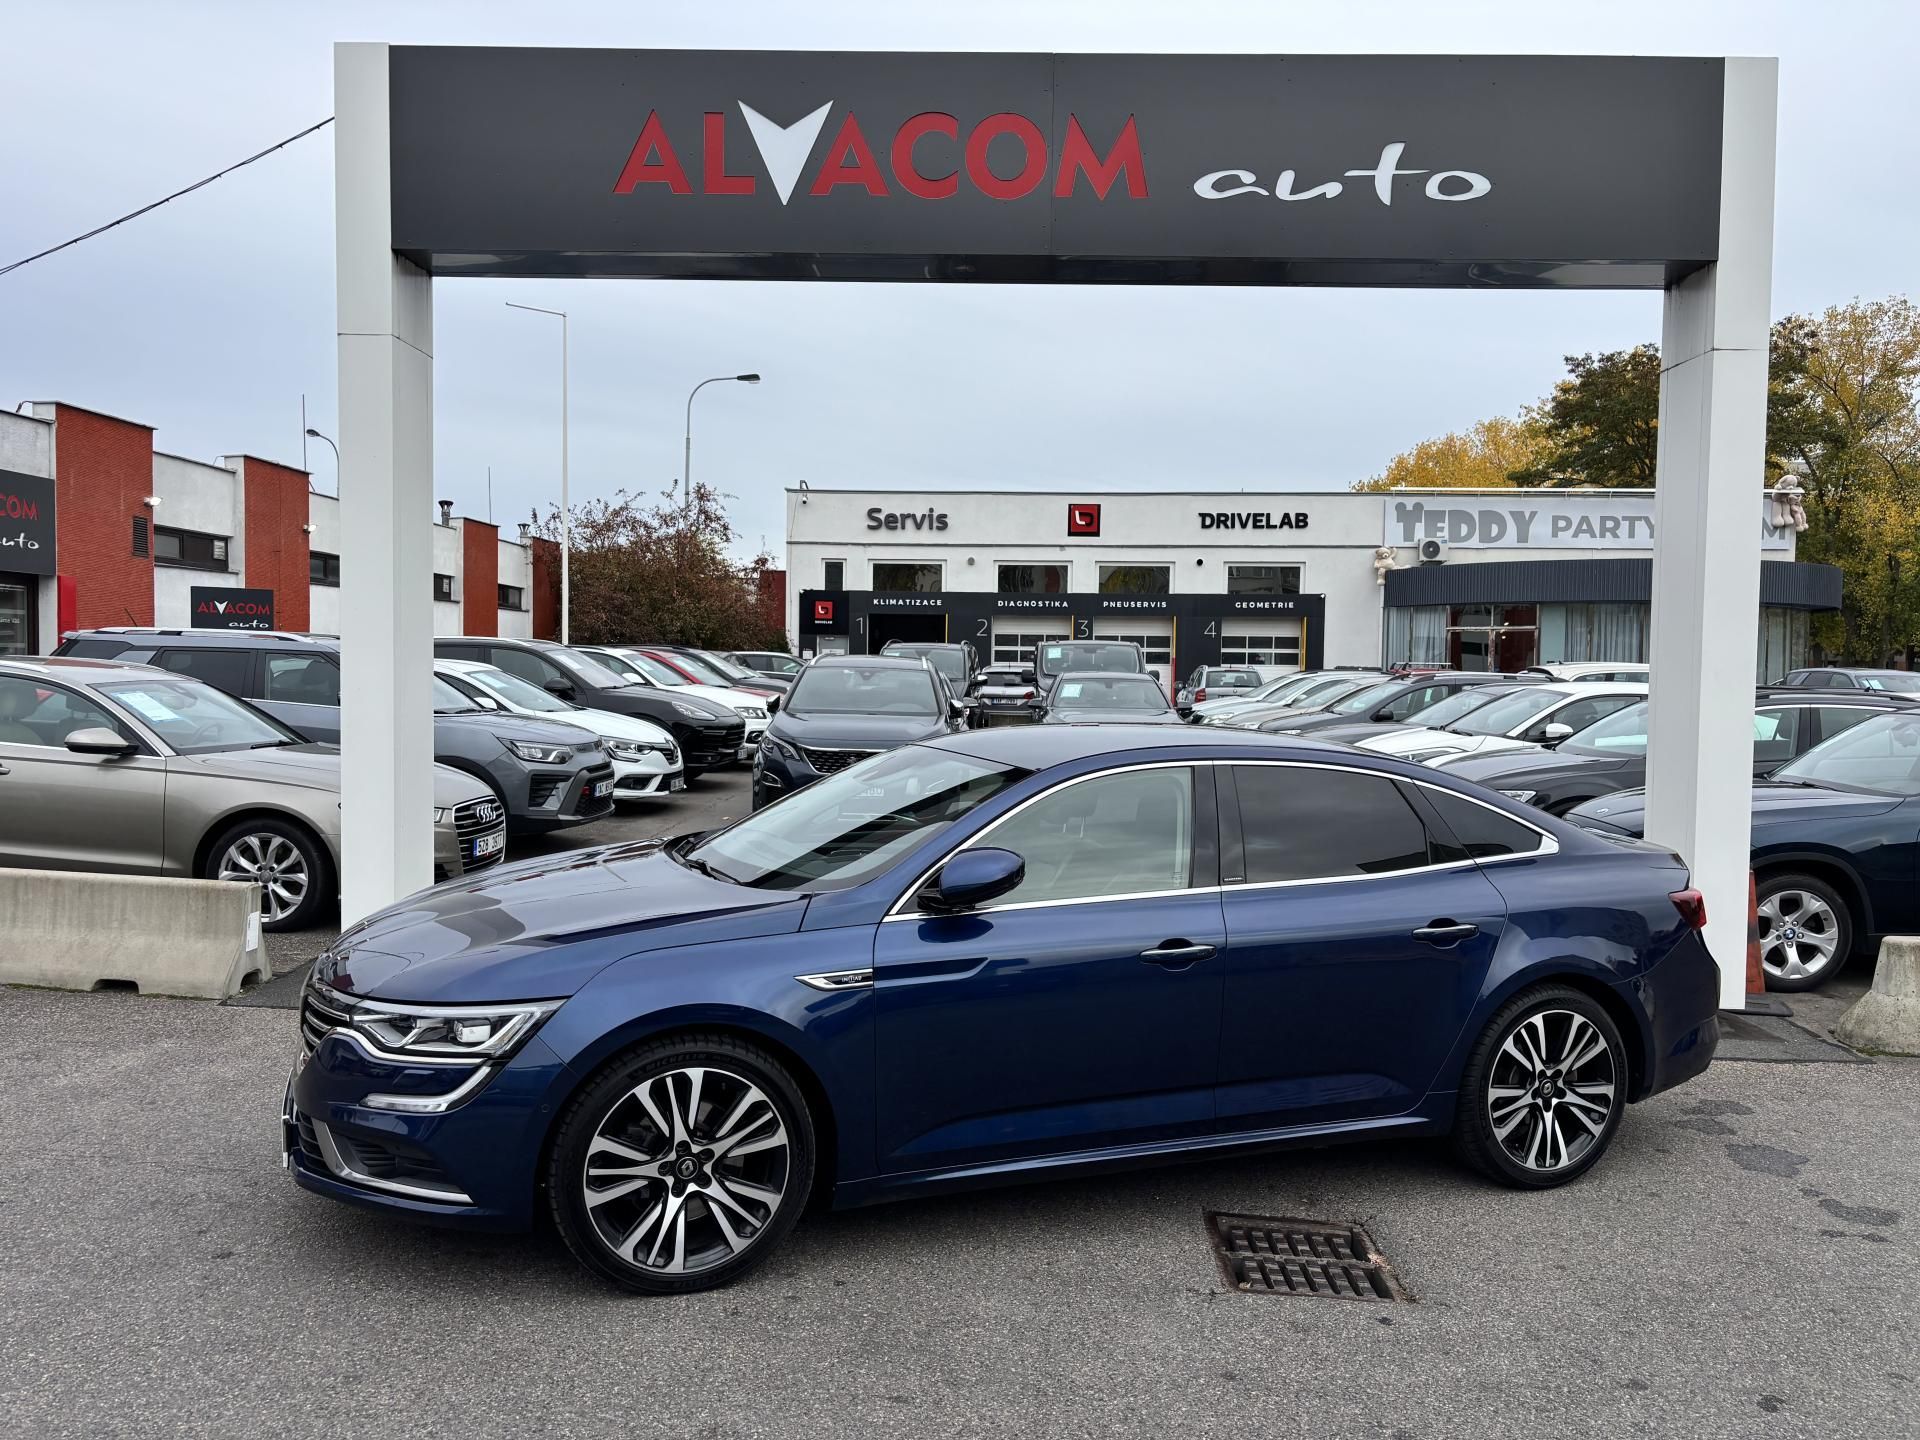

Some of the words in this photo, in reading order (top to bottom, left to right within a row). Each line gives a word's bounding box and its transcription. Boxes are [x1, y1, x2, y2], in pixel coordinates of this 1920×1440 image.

[613, 100, 1149, 205] ALVACOM
[1193, 142, 1492, 206] auto
[866, 507, 949, 530] Servis
[1198, 512, 1309, 529] DRIVELAB
[1395, 502, 1538, 543] TEDDY
[0, 532, 39, 549] uto
[197, 600, 270, 616] ALVACOM
[873, 598, 943, 606] KLIMATIZACE
[997, 600, 1069, 608] DIAGNOSTIKA
[228, 619, 269, 628] auto
[855, 617, 863, 635] 1
[976, 618, 988, 637] 2
[1077, 619, 1089, 638] 3
[1203, 621, 1217, 639] 4
